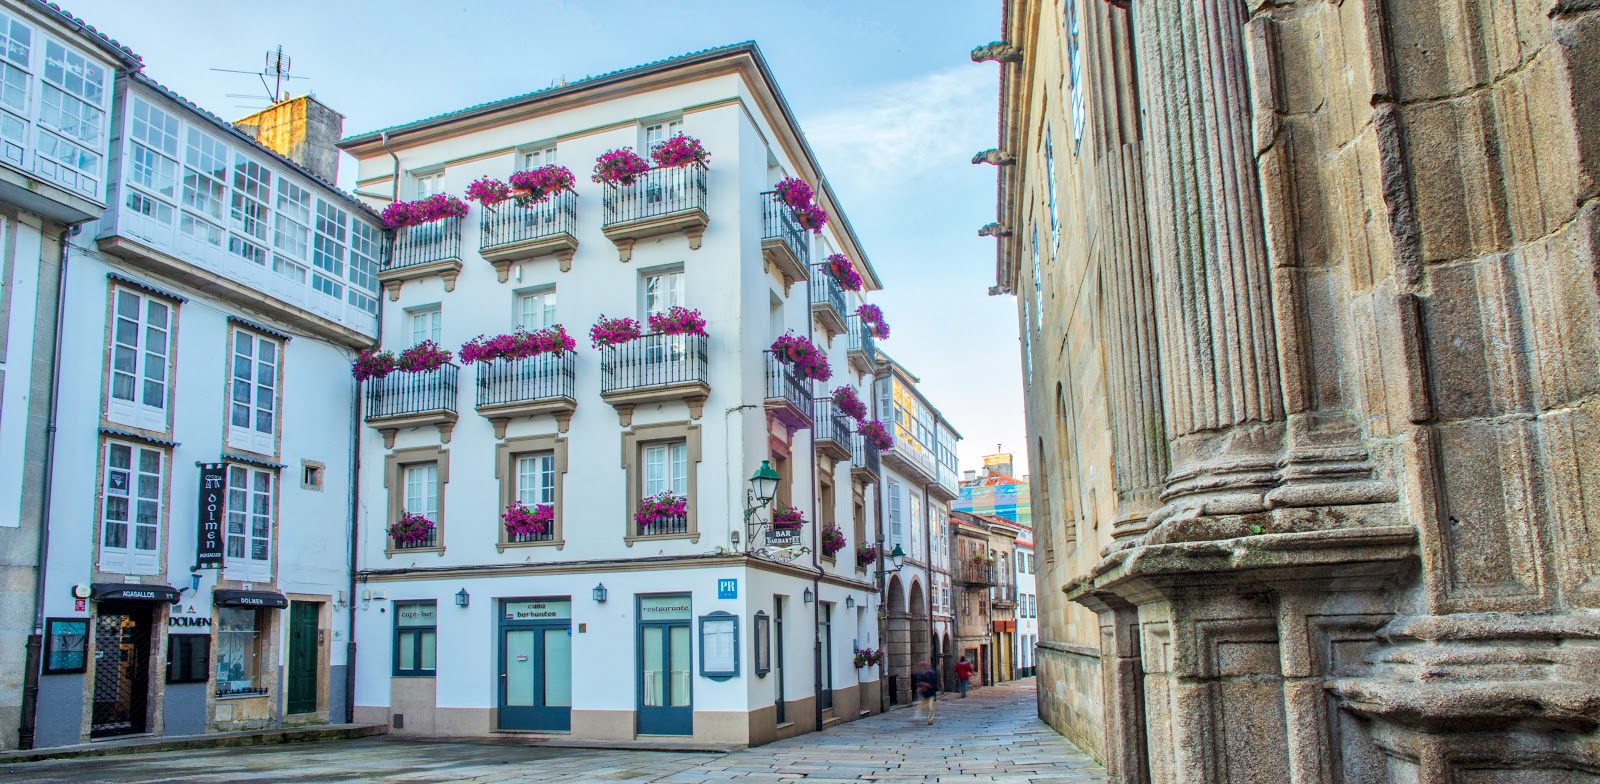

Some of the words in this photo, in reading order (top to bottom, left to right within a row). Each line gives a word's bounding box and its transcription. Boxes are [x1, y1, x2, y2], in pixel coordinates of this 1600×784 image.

[720, 581, 735, 592] PR
[240, 597, 264, 605] DOLMEN
[168, 617, 213, 627] DOLMEN
